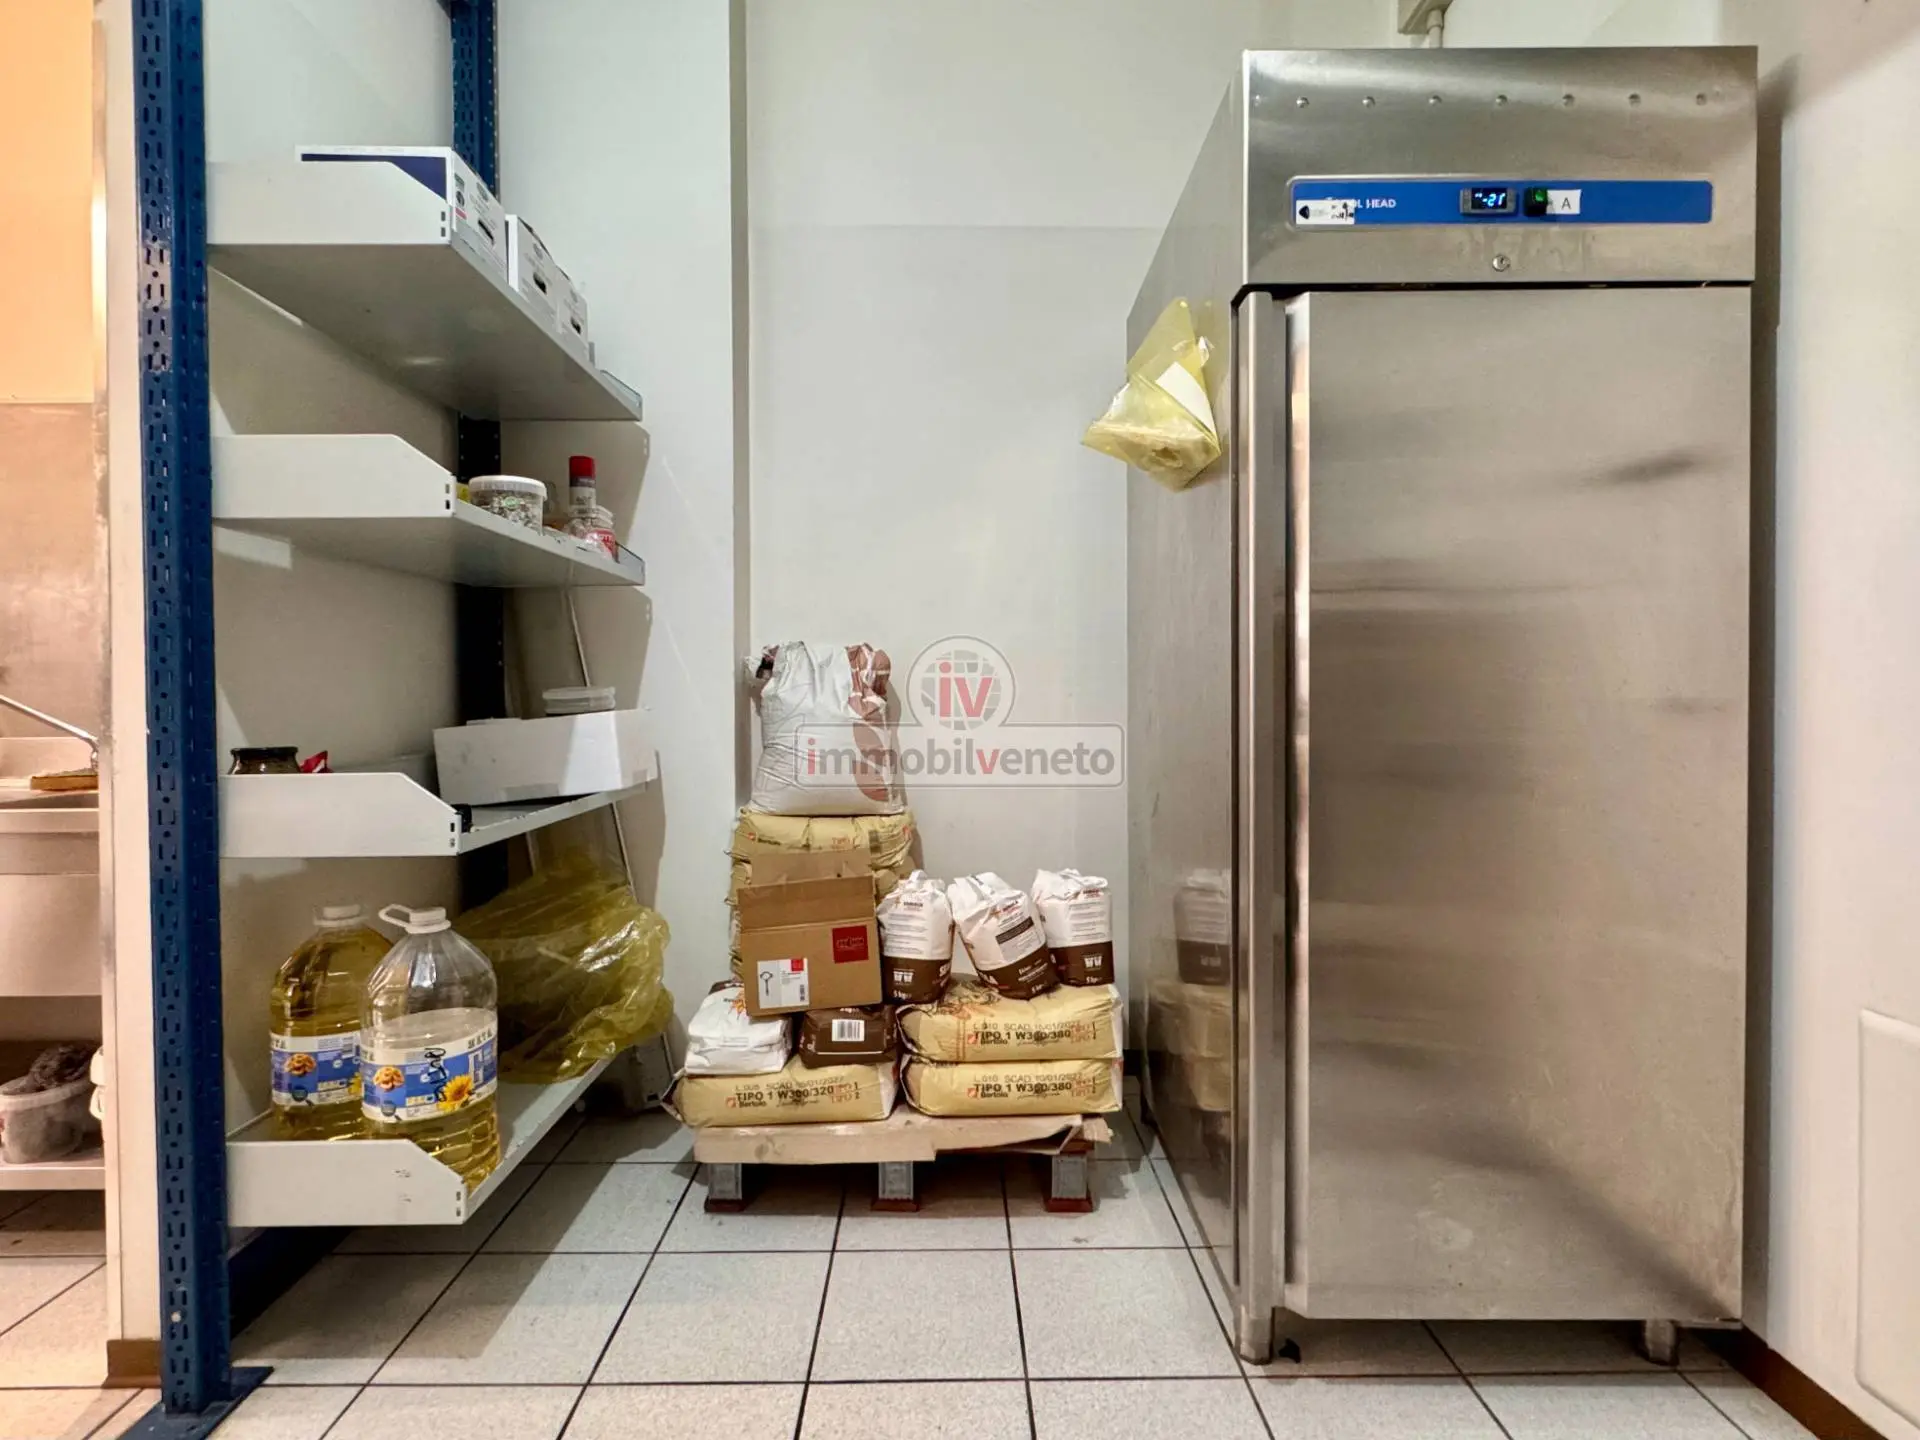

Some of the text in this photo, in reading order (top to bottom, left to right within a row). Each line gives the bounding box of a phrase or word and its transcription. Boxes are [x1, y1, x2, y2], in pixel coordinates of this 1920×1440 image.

[1366, 199, 1397, 209] HEAD
[1561, 197, 1571, 209] A
[973, 1030, 1002, 1041] TIPO
[1005, 1031, 1011, 1040] 1
[973, 1083, 1002, 1093] TIPO
[1006, 1083, 1012, 1092] 1
[735, 1091, 764, 1101] TIPO
[768, 1090, 773, 1100] 1
